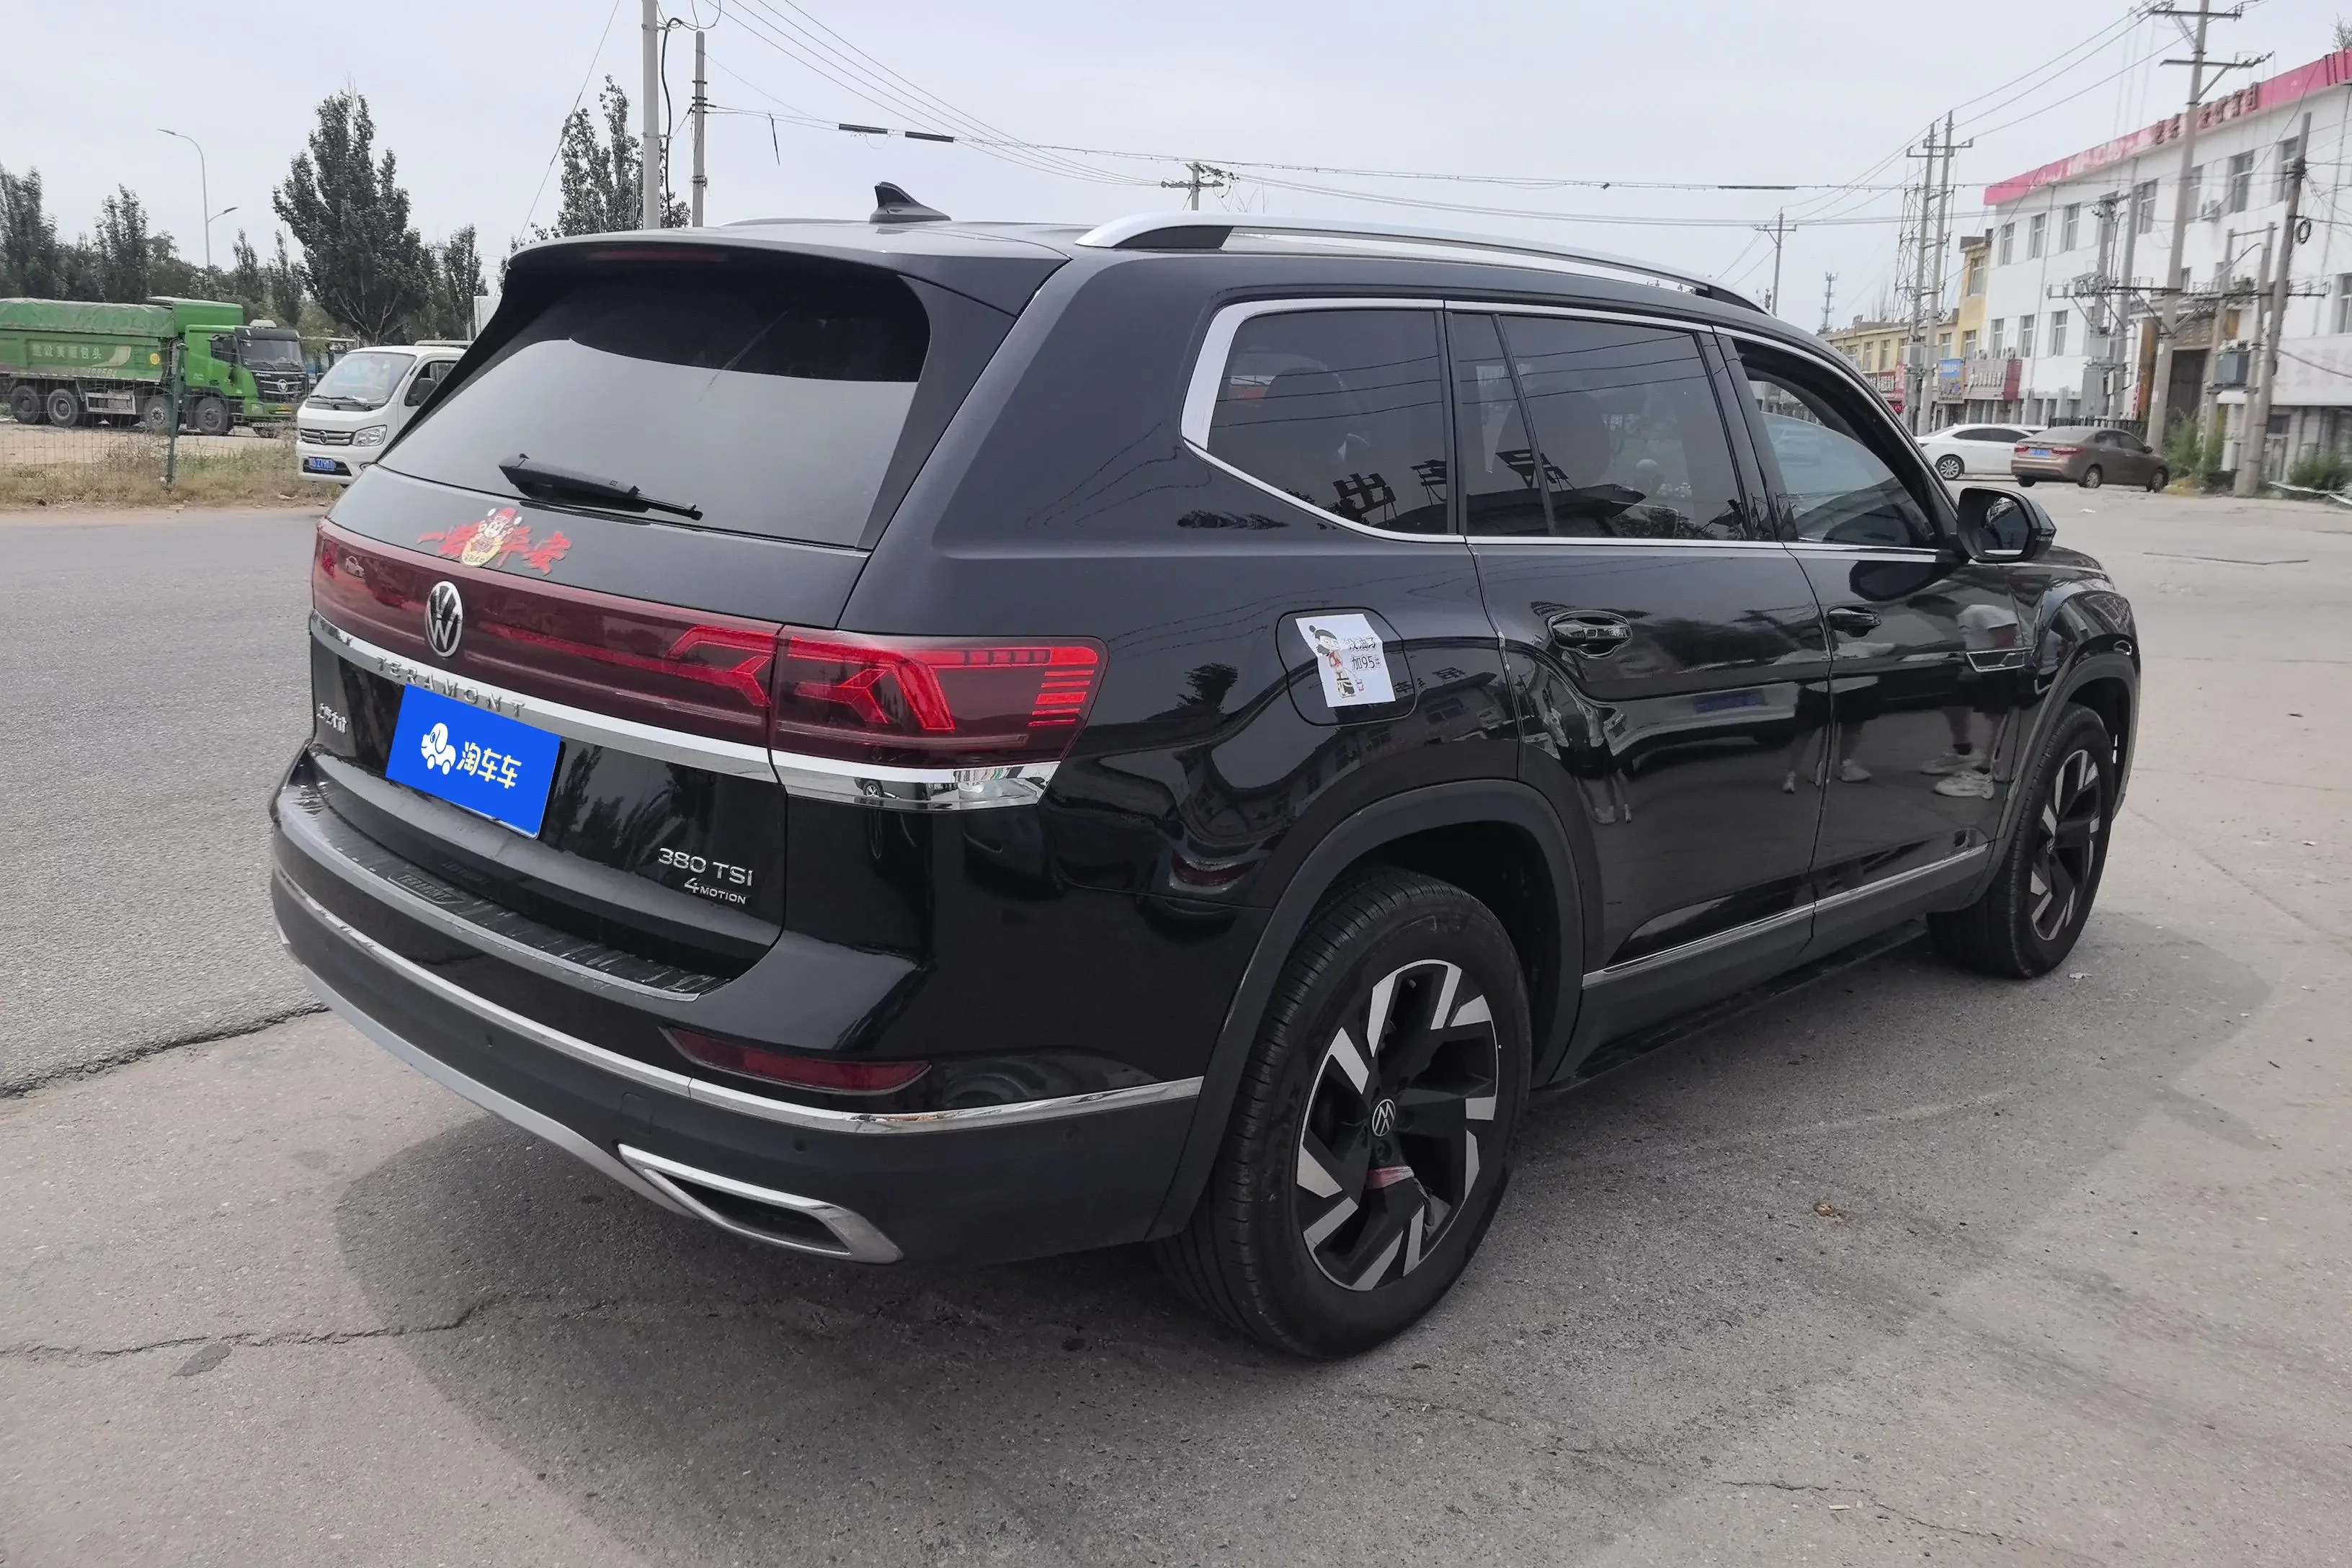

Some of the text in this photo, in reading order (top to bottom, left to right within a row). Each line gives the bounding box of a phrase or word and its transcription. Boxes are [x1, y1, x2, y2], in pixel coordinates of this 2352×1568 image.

[375, 655, 525, 718] TERAMONT
[658, 847, 754, 886] 380 TSI
[684, 878, 747, 905] 4MOTION
